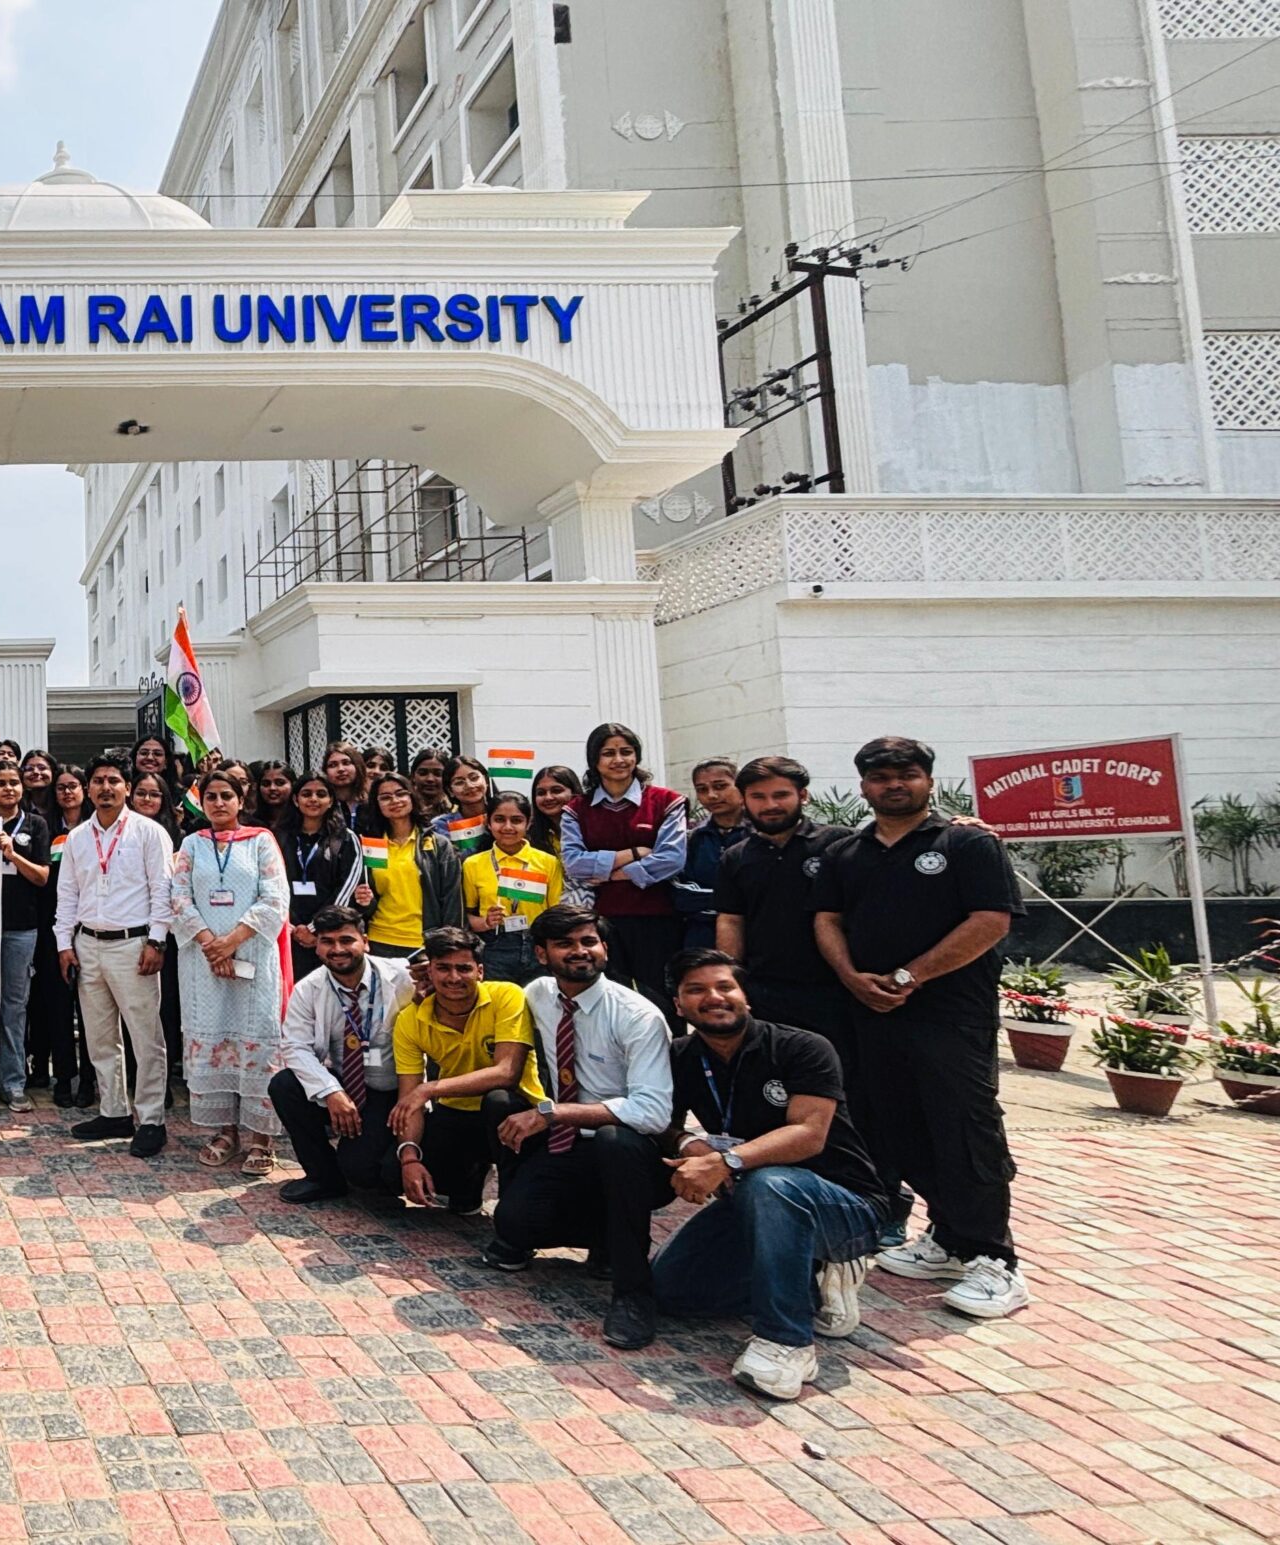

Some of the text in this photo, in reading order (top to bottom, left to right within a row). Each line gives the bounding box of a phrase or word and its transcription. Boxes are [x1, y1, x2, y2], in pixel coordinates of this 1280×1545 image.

[87, 294, 193, 345] RAI
[213, 294, 585, 344] UNIVERSITY
[983, 758, 1162, 799] NATIONAL CADET CORPS
[991, 815, 1170, 832] HRI GURU RAM RAI UNIVERSITY, DEHRADUN
[1028, 811, 1038, 820] 11
[1039, 810, 1051, 819] UK
[1052, 809, 1078, 819] GIRLS
[1095, 807, 1114, 816] NCC
